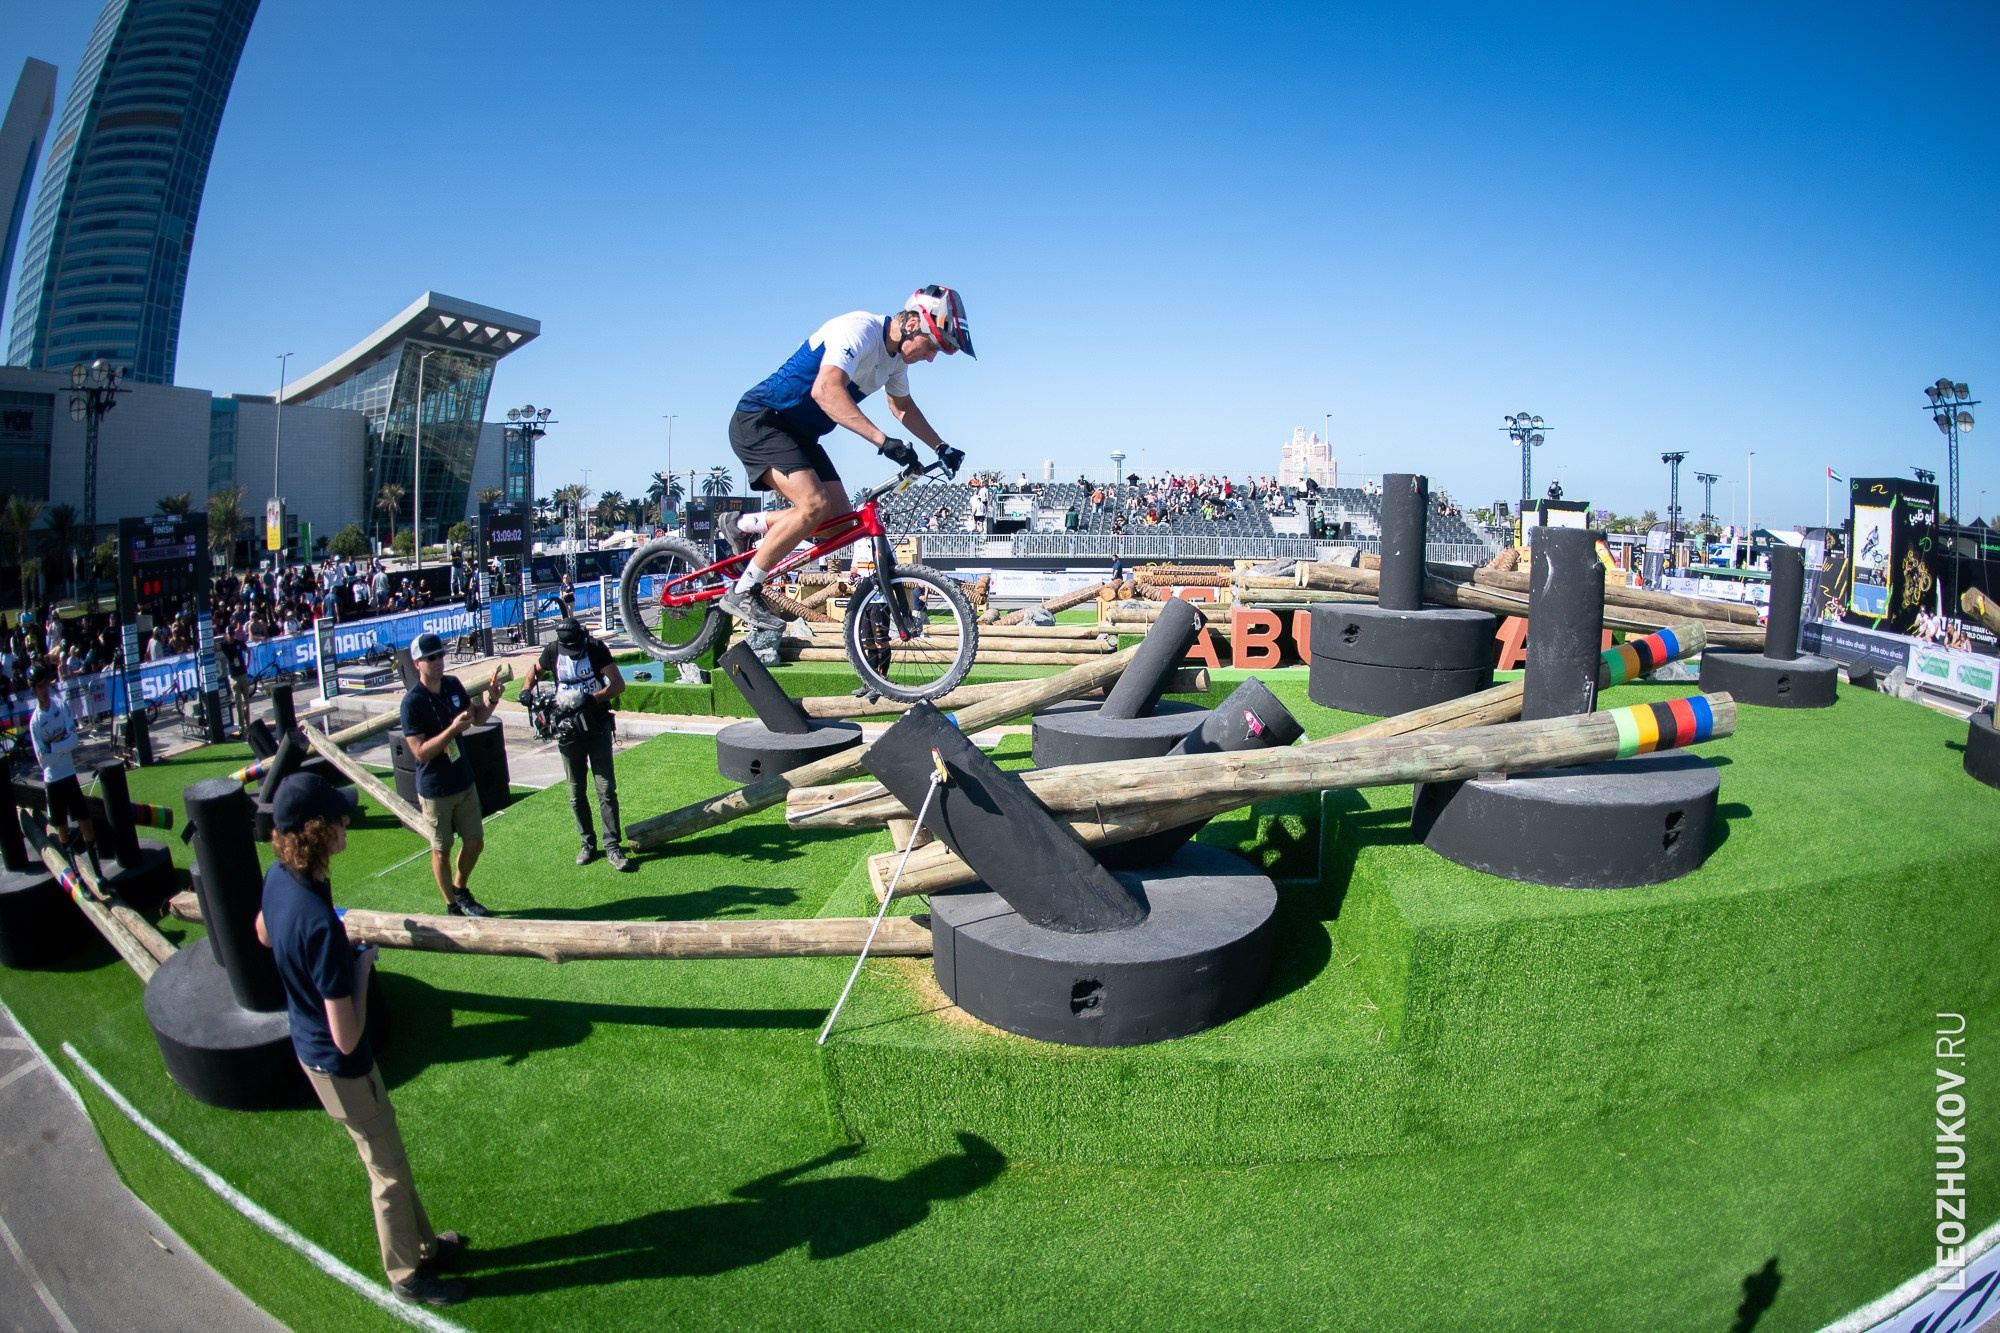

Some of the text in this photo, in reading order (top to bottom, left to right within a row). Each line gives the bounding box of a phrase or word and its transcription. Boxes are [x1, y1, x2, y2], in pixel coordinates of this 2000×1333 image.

[153, 525, 174, 534] FINISH
[492, 529, 522, 542] 13:09:02
[323, 638, 333, 653] 4
[372, 675, 386, 687] UCI
